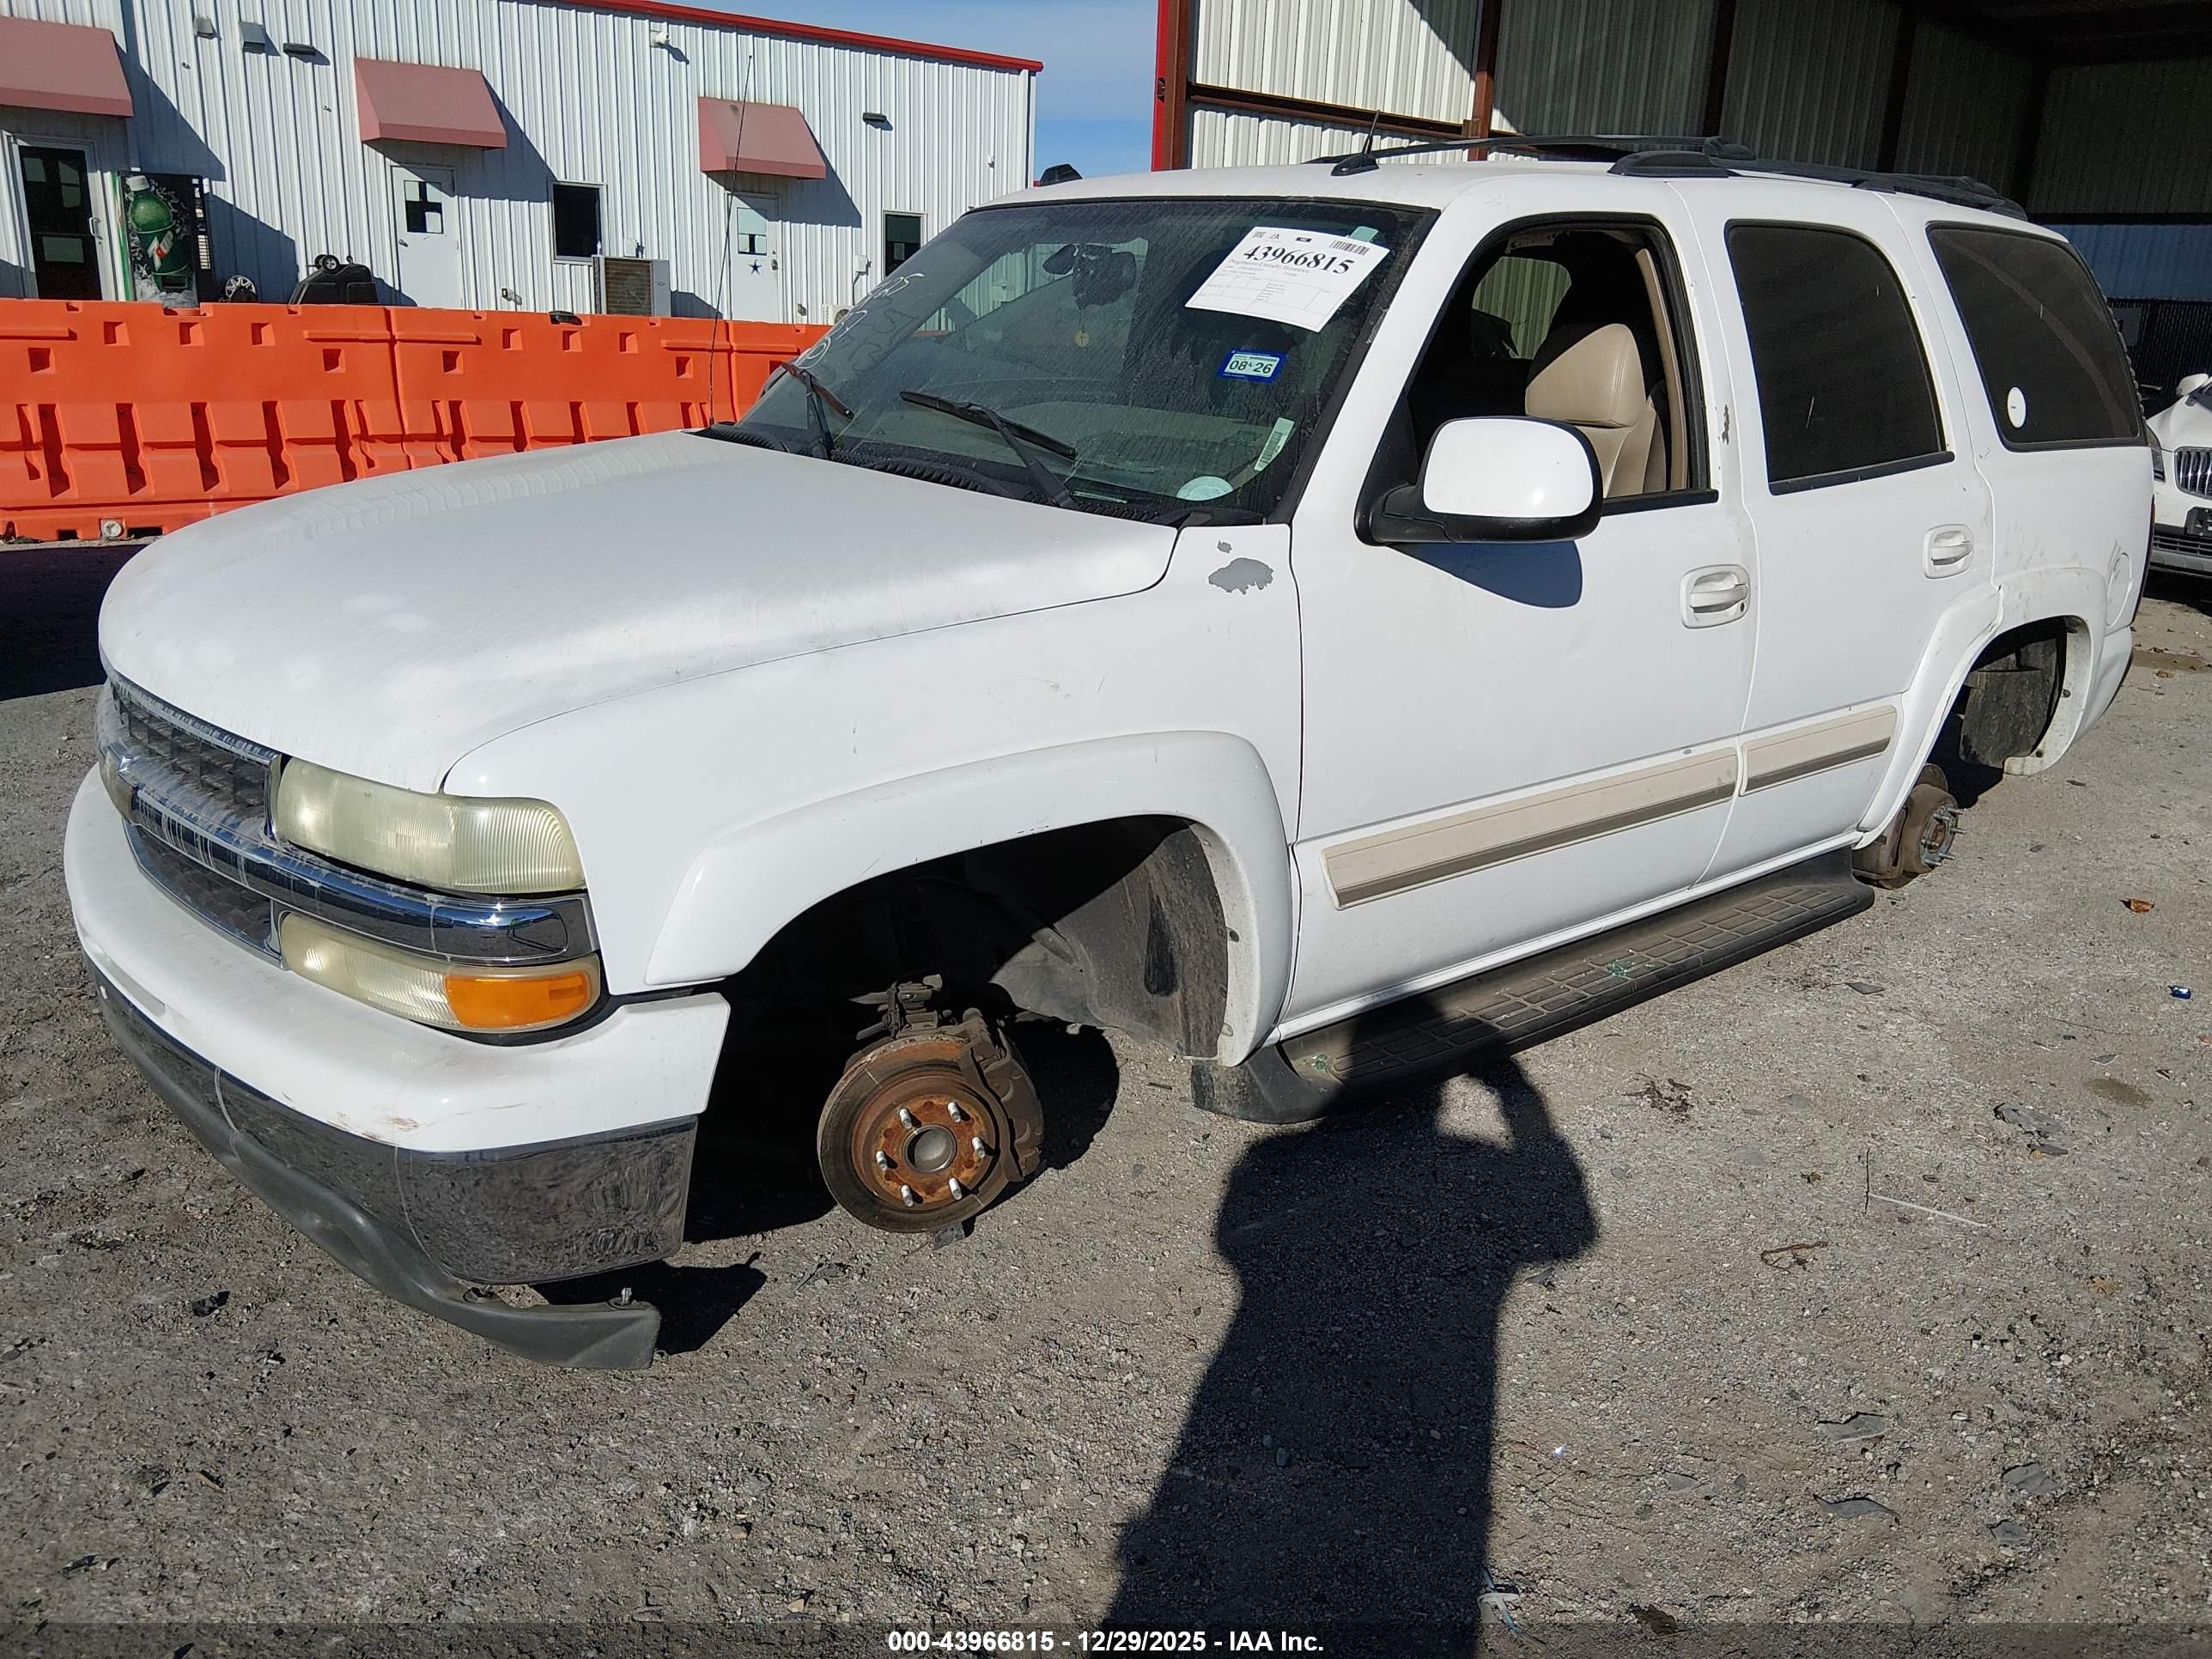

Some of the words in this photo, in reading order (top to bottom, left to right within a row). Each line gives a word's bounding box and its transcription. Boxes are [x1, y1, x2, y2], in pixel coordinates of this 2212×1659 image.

[1243, 245, 1356, 275] 43966815
[1229, 360, 1249, 371] 08
[1253, 362, 1273, 374] 26
